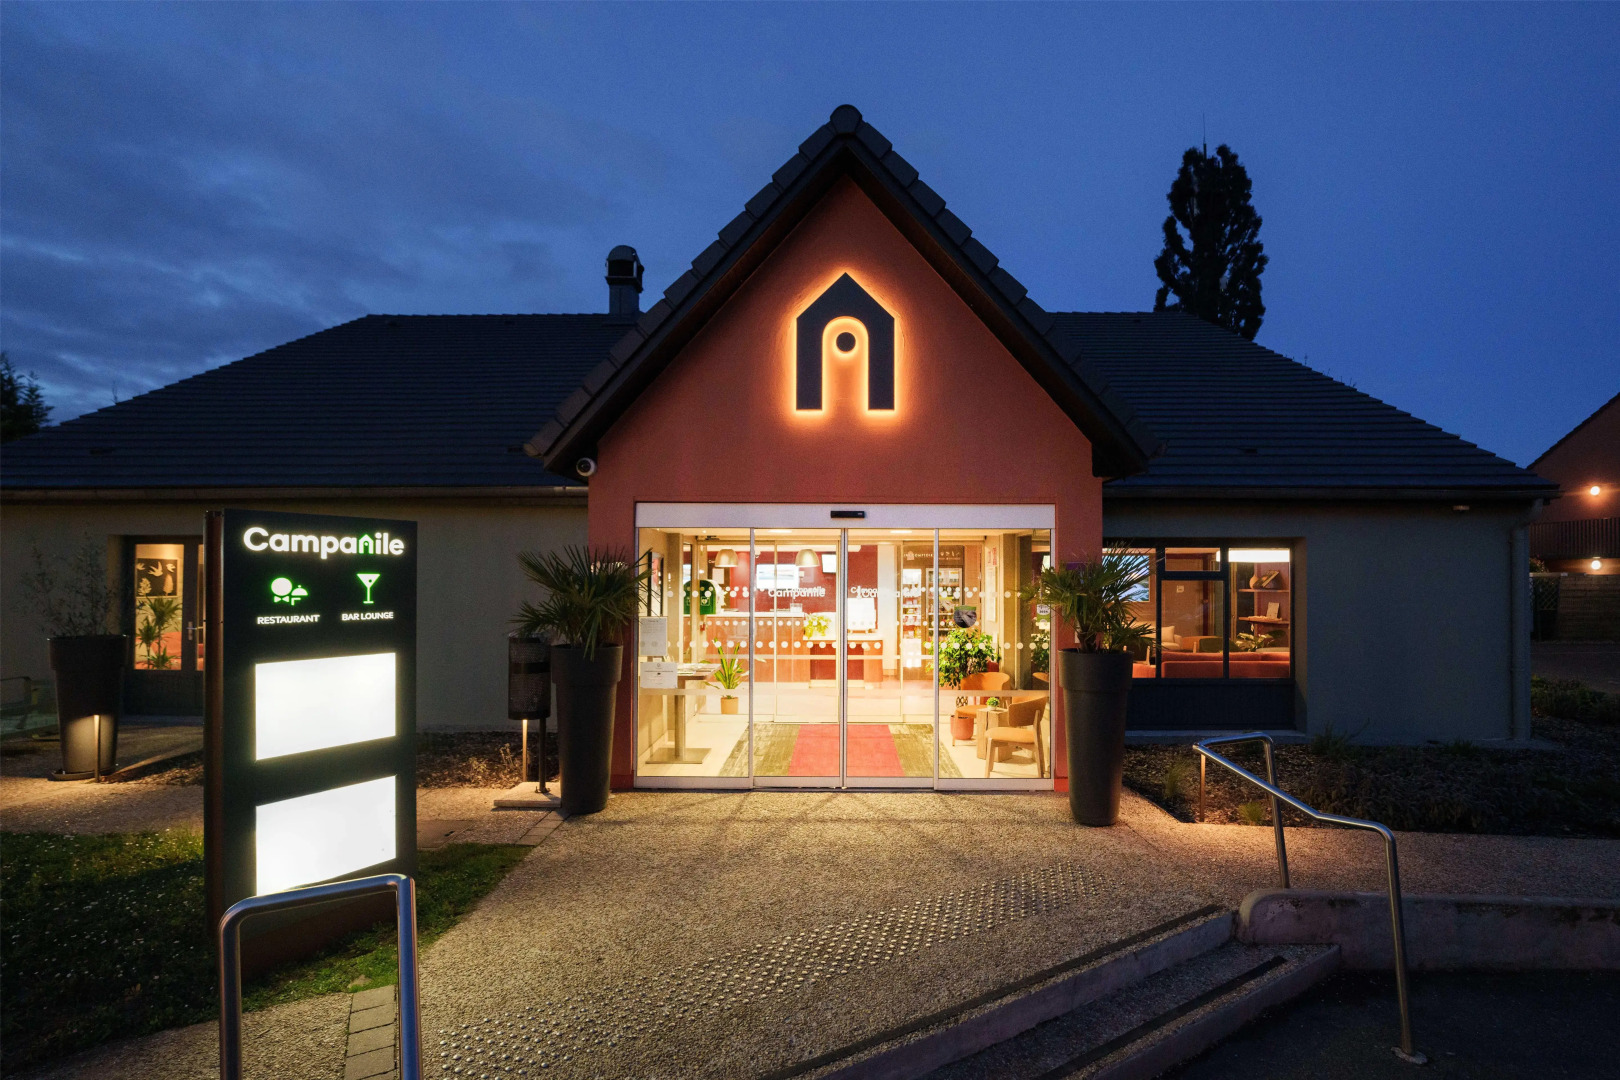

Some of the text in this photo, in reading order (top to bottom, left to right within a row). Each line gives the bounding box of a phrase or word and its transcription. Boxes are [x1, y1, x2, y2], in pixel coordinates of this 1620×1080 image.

[243, 526, 405, 559] Campanile
[256, 614, 320, 625] RESTAURANT
[341, 611, 394, 621] BAR LOUNGE
